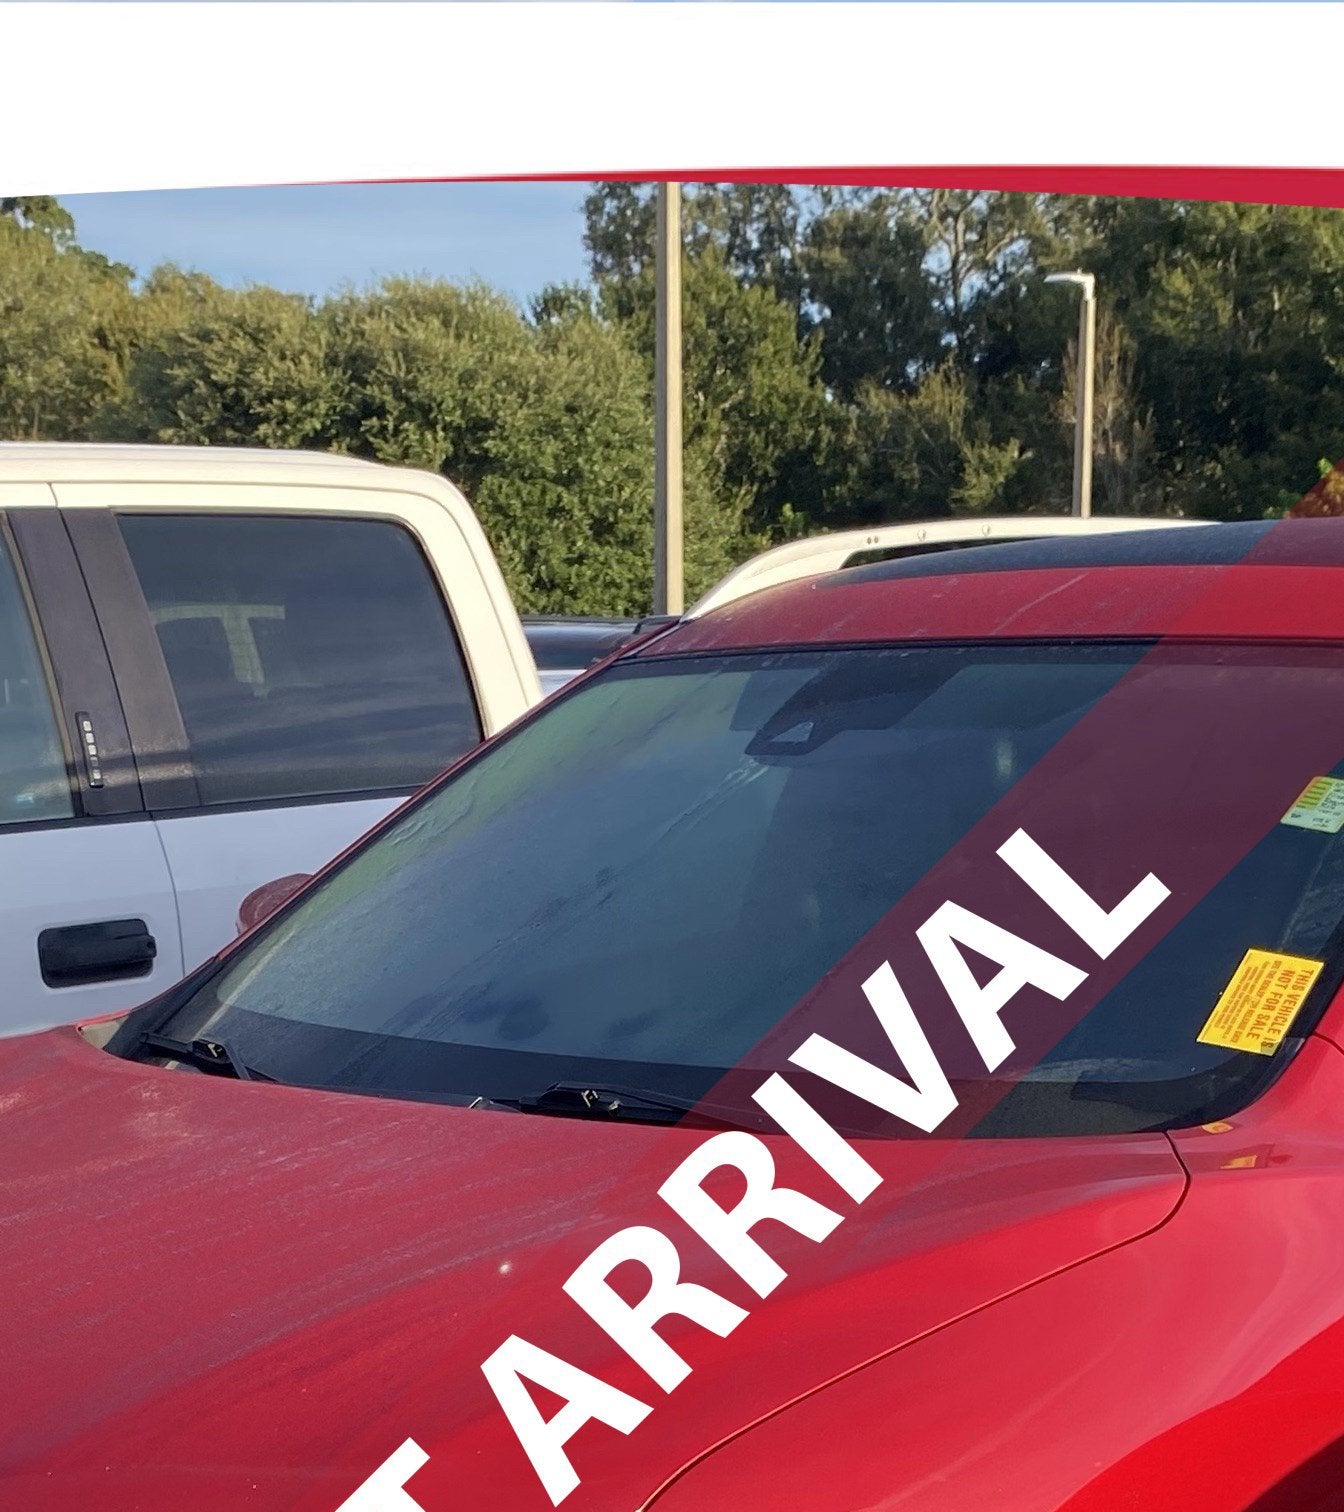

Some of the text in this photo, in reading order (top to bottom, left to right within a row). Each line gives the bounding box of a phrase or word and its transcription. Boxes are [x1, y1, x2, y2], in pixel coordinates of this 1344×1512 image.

[1246, 969, 1296, 1041] NOT FOR SALE
[1260, 969, 1315, 1049] THIS VEHICLE IS
